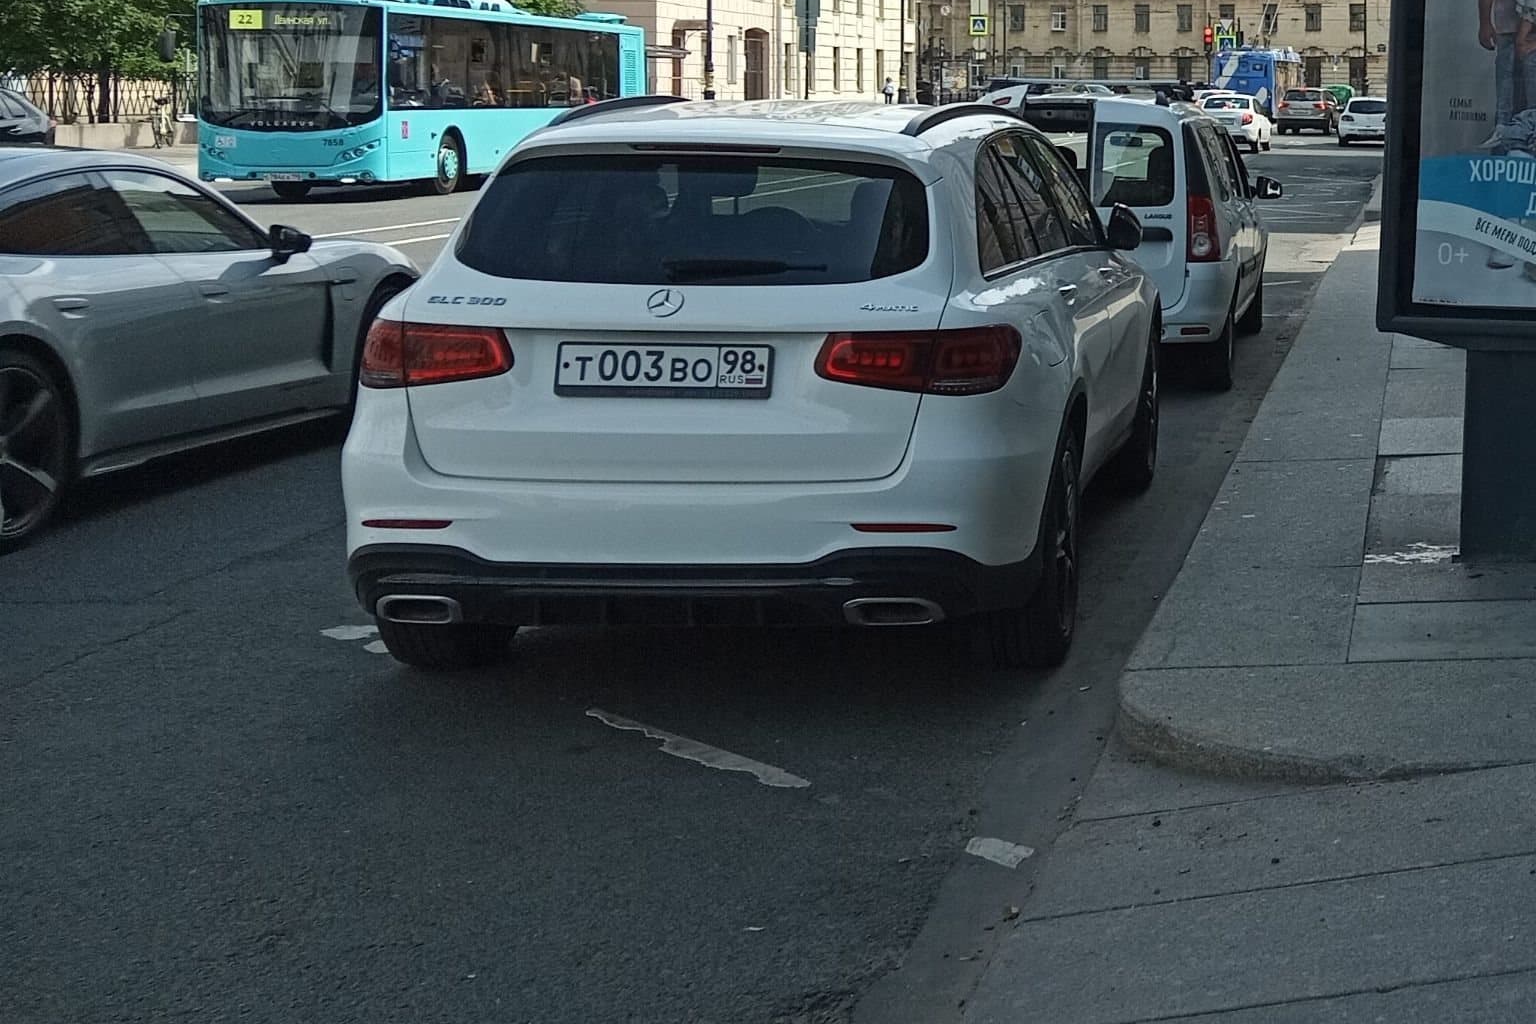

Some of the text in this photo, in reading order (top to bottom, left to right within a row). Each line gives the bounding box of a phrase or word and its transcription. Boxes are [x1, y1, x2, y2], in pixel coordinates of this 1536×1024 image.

[237, 14, 253, 25] 22
[1475, 217, 1491, 234] ВСЕ
[1492, 225, 1516, 244] МЕРЫ
[1437, 243, 1469, 266] 0+
[427, 296, 508, 306] GLC 300
[723, 350, 757, 375] 98
[719, 374, 745, 385] RUS
